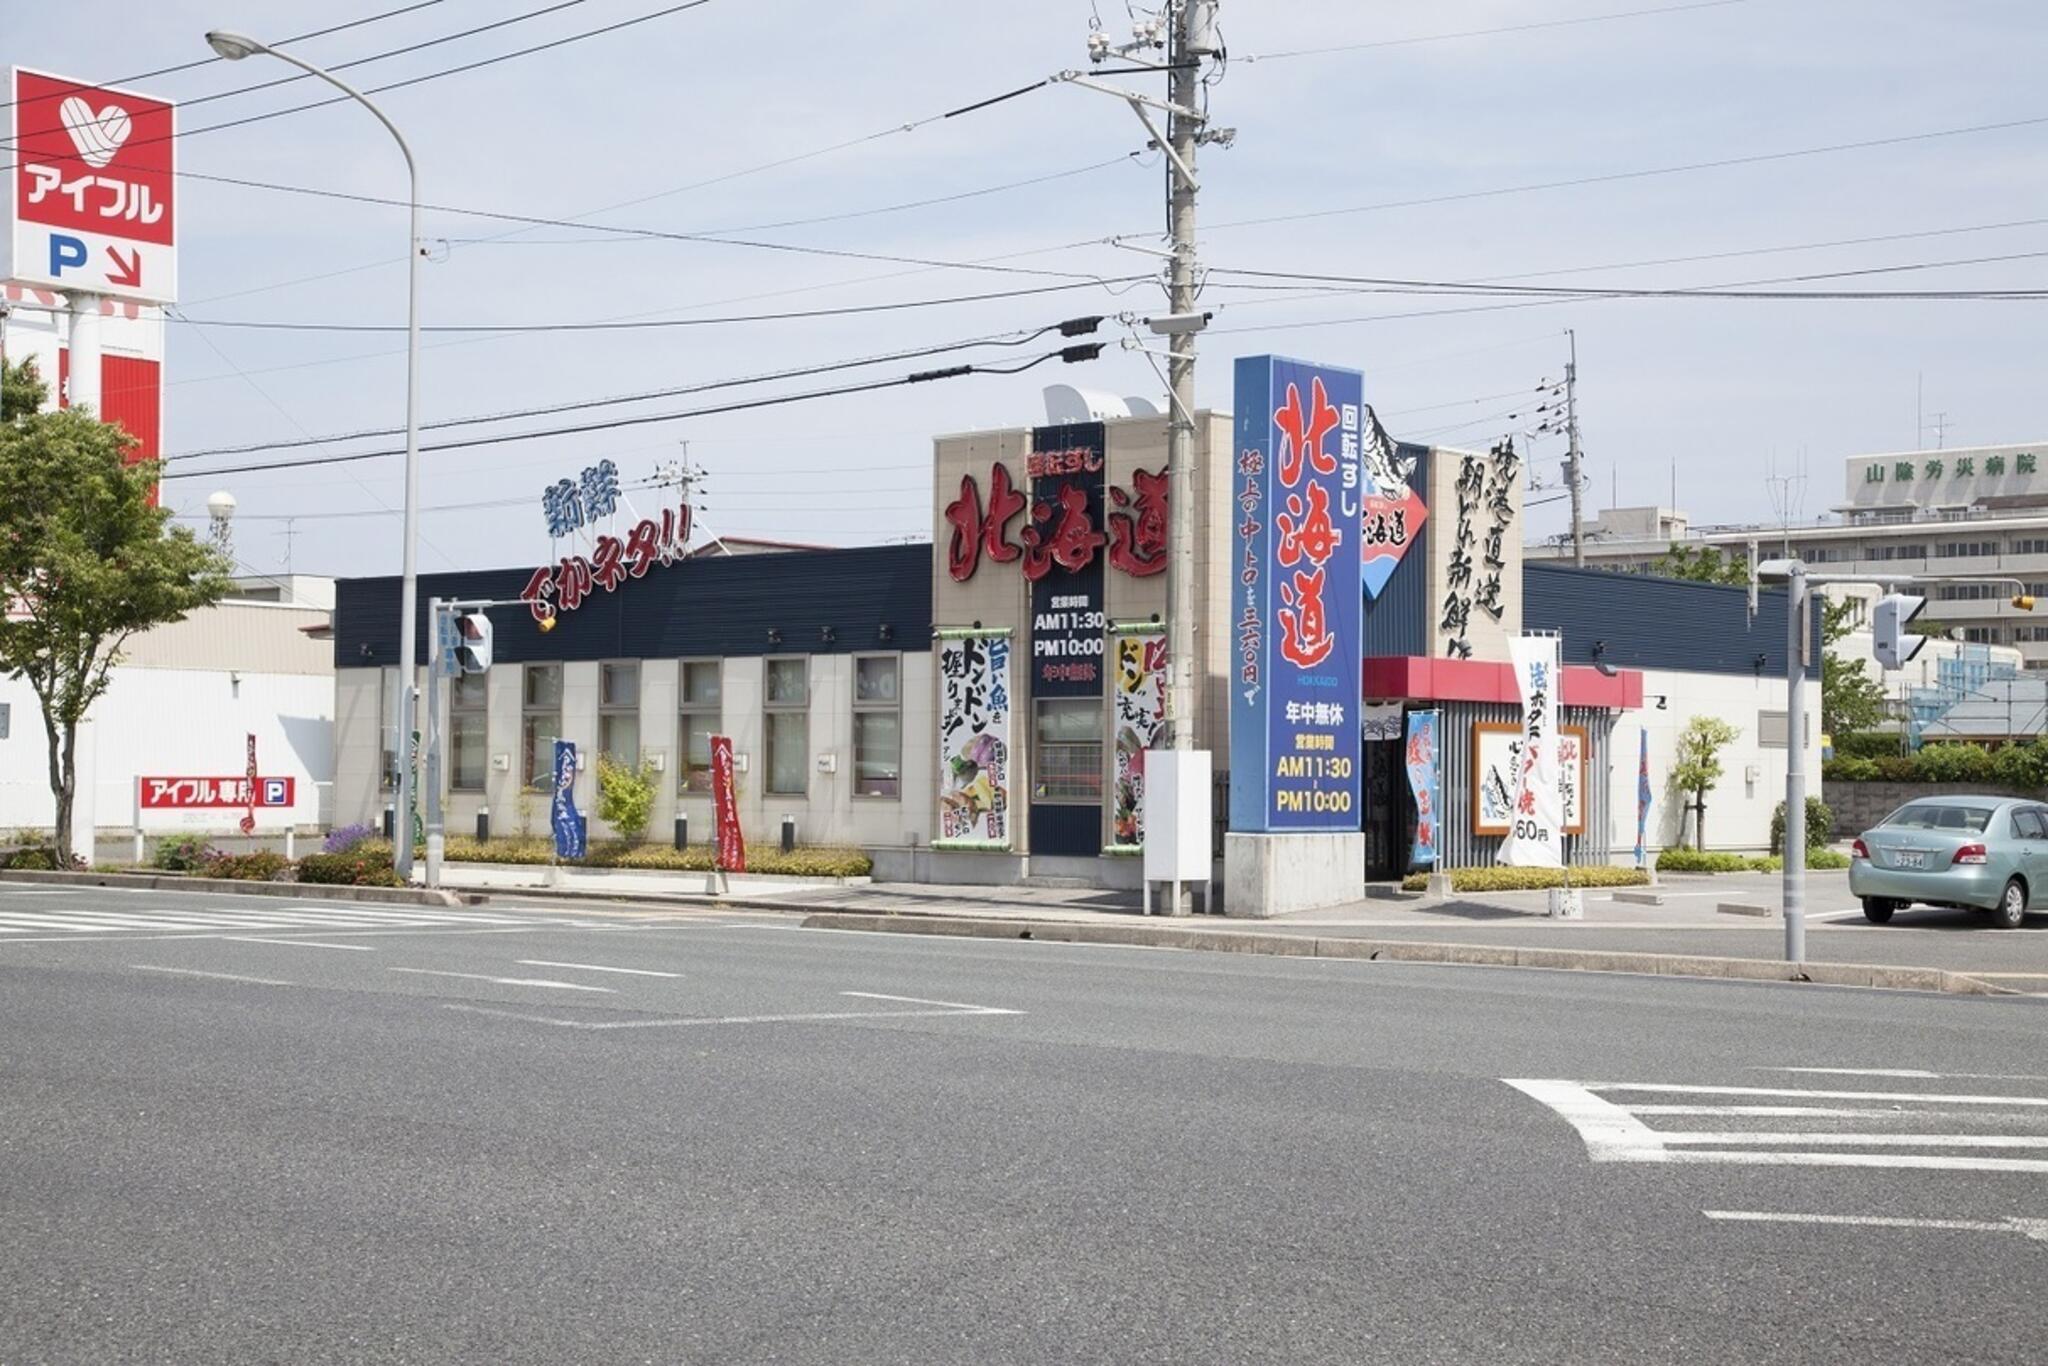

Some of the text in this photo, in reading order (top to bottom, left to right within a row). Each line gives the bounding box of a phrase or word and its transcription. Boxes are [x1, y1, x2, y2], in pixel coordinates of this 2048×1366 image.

[24, 162, 164, 225] アイフル
[50, 234, 88, 278] P
[1340, 403, 1358, 518] 回転すし
[944, 461, 1168, 584] 北海道
[1273, 376, 1343, 669] 北海道
[1362, 508, 1408, 547] 海道
[1050, 595, 1089, 608] 営業時間
[1034, 612, 1104, 630] AM11:30
[1034, 638, 1104, 656] PM10:00
[963, 638, 989, 734] ドンドン
[1296, 676, 1338, 688] HOKKAIDO
[1285, 700, 1345, 727] 年中無休
[1295, 734, 1335, 751] 営業時間
[1276, 756, 1352, 778] AM11:30
[267, 783, 284, 802] P
[1276, 790, 1352, 812] PM10:00
[1514, 820, 1549, 842] 60円
